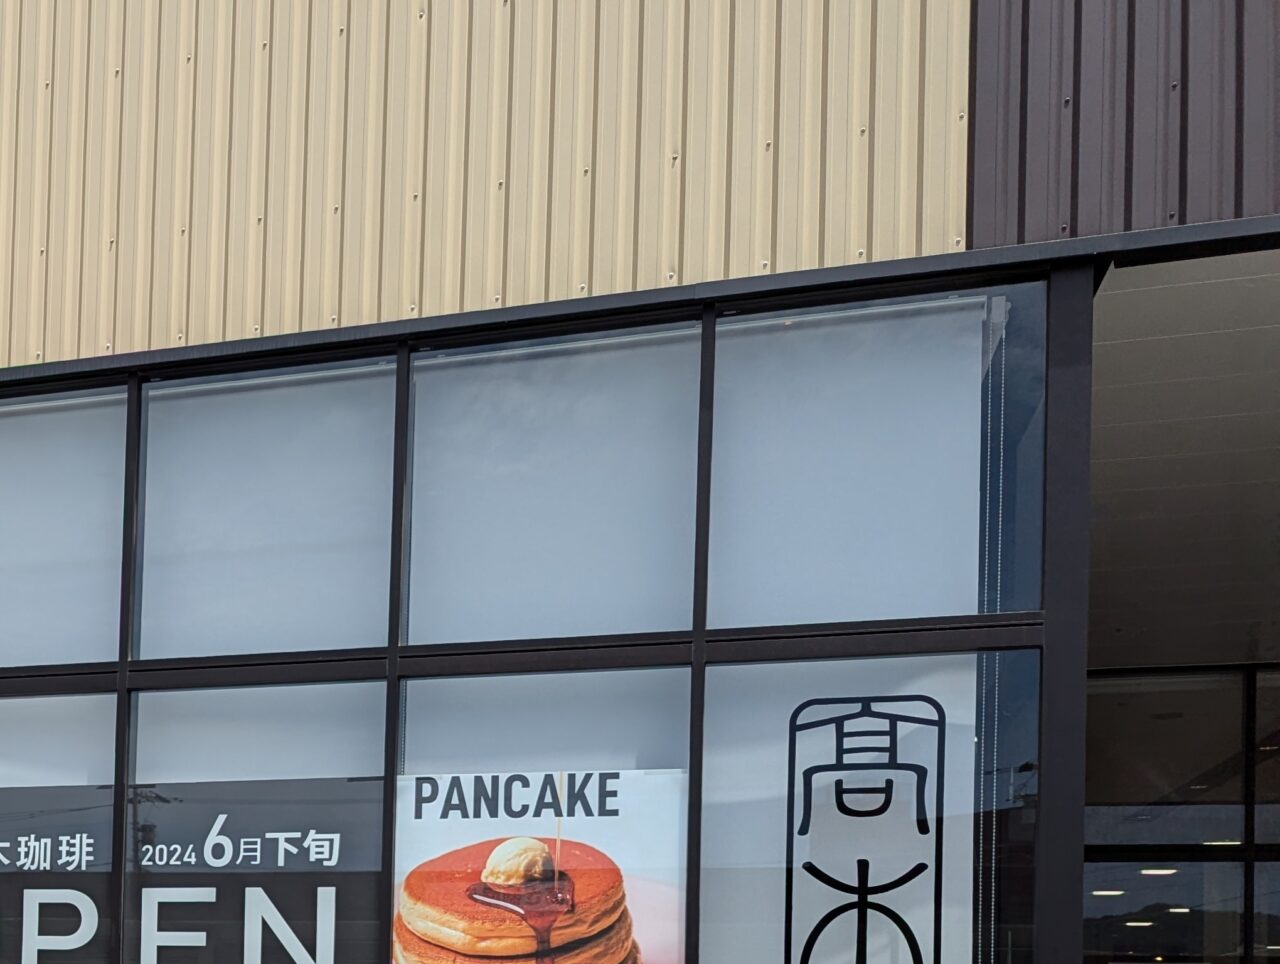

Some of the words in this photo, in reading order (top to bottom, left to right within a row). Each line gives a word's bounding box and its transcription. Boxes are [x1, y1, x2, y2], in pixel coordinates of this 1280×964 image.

[414, 772, 621, 820] PANCAKE
[141, 843, 197, 866] 2024
[203, 813, 341, 867] 6月下旬
